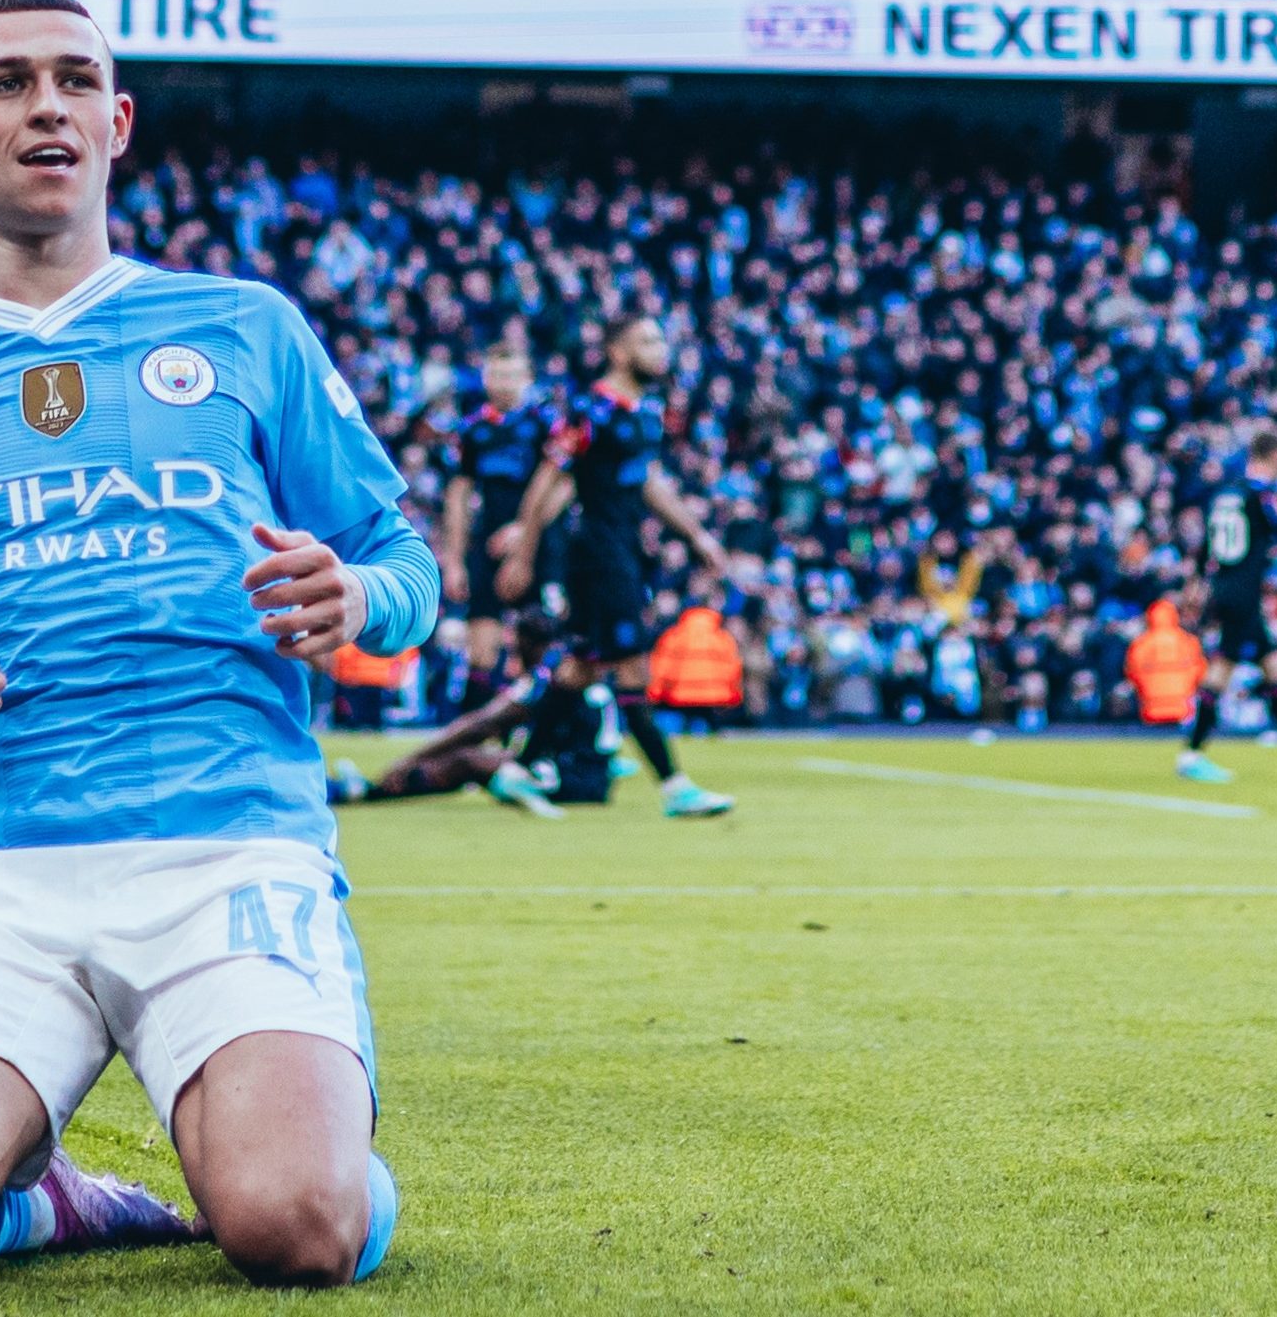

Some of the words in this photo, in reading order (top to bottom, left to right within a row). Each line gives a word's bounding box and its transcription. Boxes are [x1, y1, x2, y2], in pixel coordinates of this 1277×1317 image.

[883, 1, 1140, 62] NEXEN
[41, 406, 70, 422] FIFA
[171, 394, 194, 402] CITY
[228, 880, 318, 963] 47
